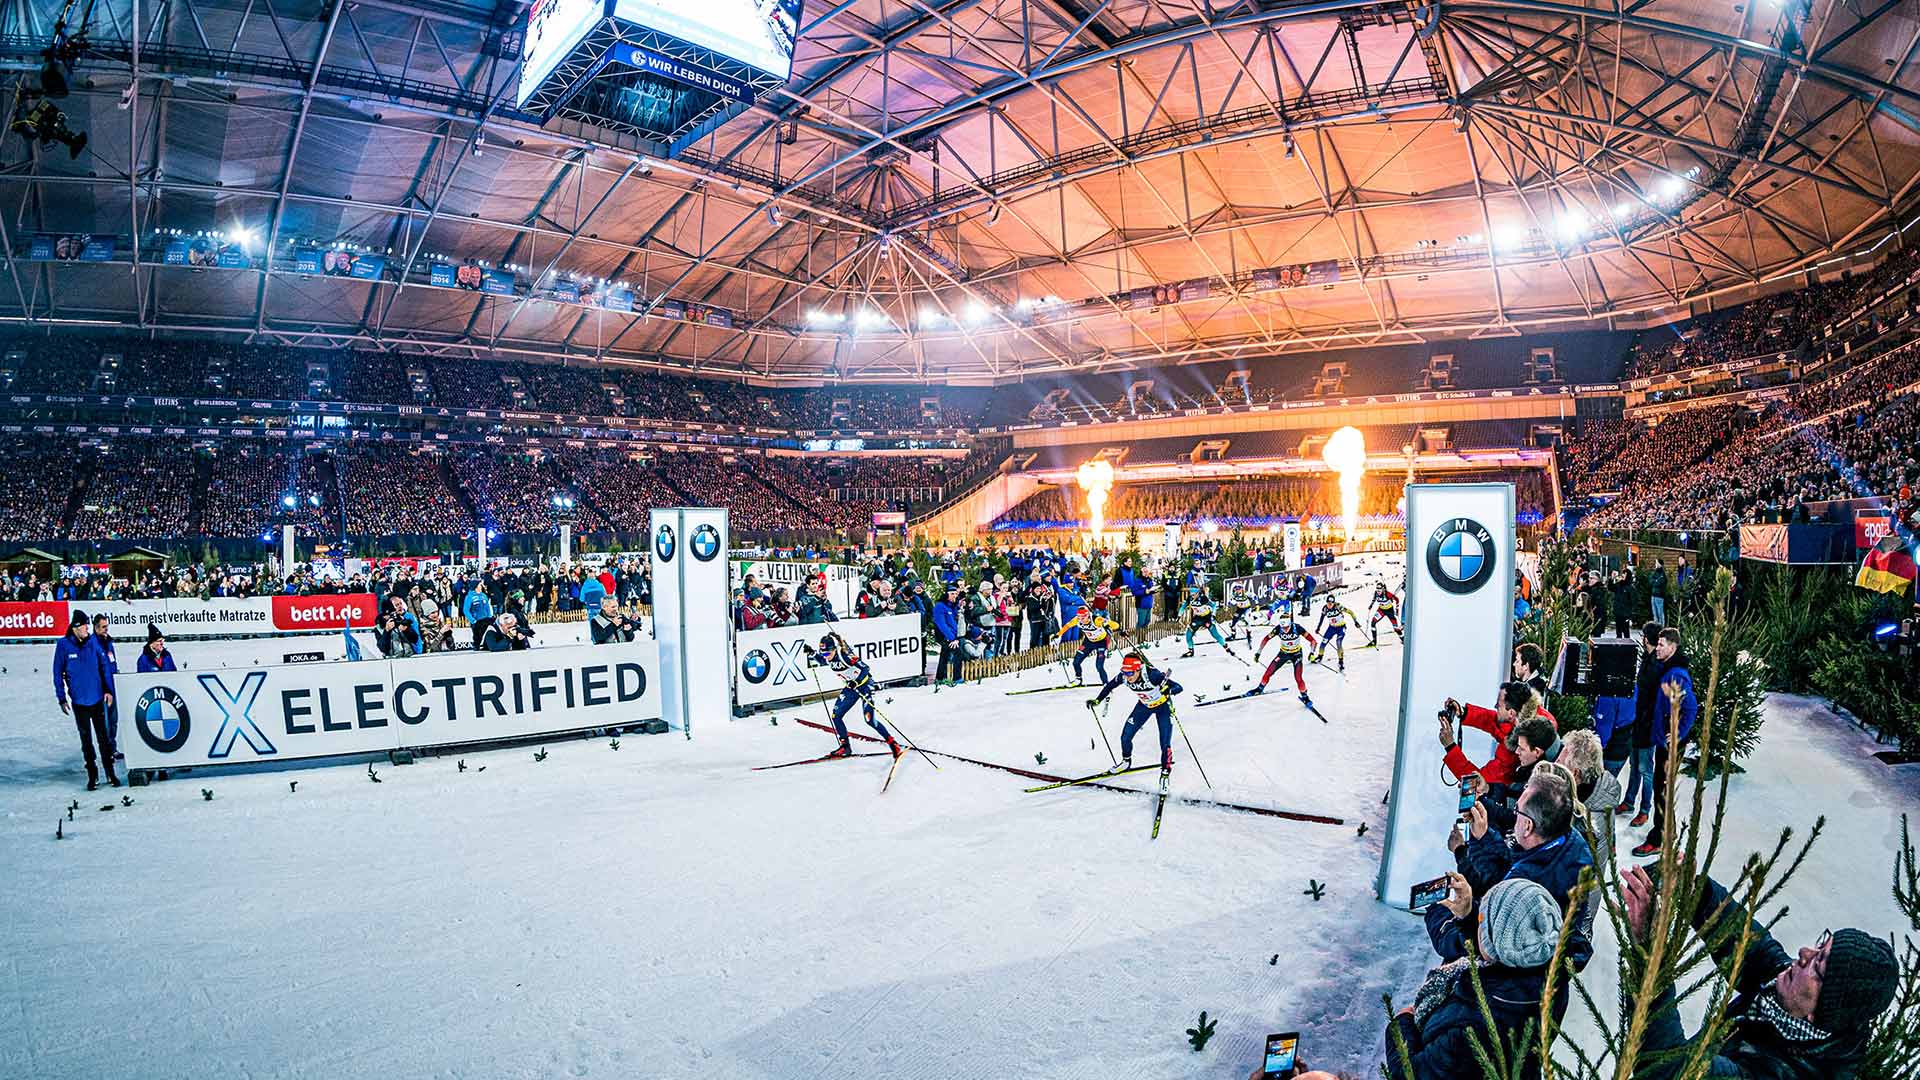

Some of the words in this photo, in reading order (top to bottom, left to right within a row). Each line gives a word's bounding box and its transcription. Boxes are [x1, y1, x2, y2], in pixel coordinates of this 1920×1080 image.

[648, 57, 672, 72] WIR
[674, 66, 711, 86] LEBEN
[712, 80, 740, 96] DICH
[1374, 541, 1403, 551] VELTINS
[767, 564, 812, 580] VELTINS
[220, 610, 266, 622] Matratze
[290, 604, 362, 622] bett1.de
[771, 639, 807, 686] X
[854, 636, 920, 660] TRIFIED
[197, 672, 278, 758] X
[281, 662, 647, 735] ELECTRIFIED
